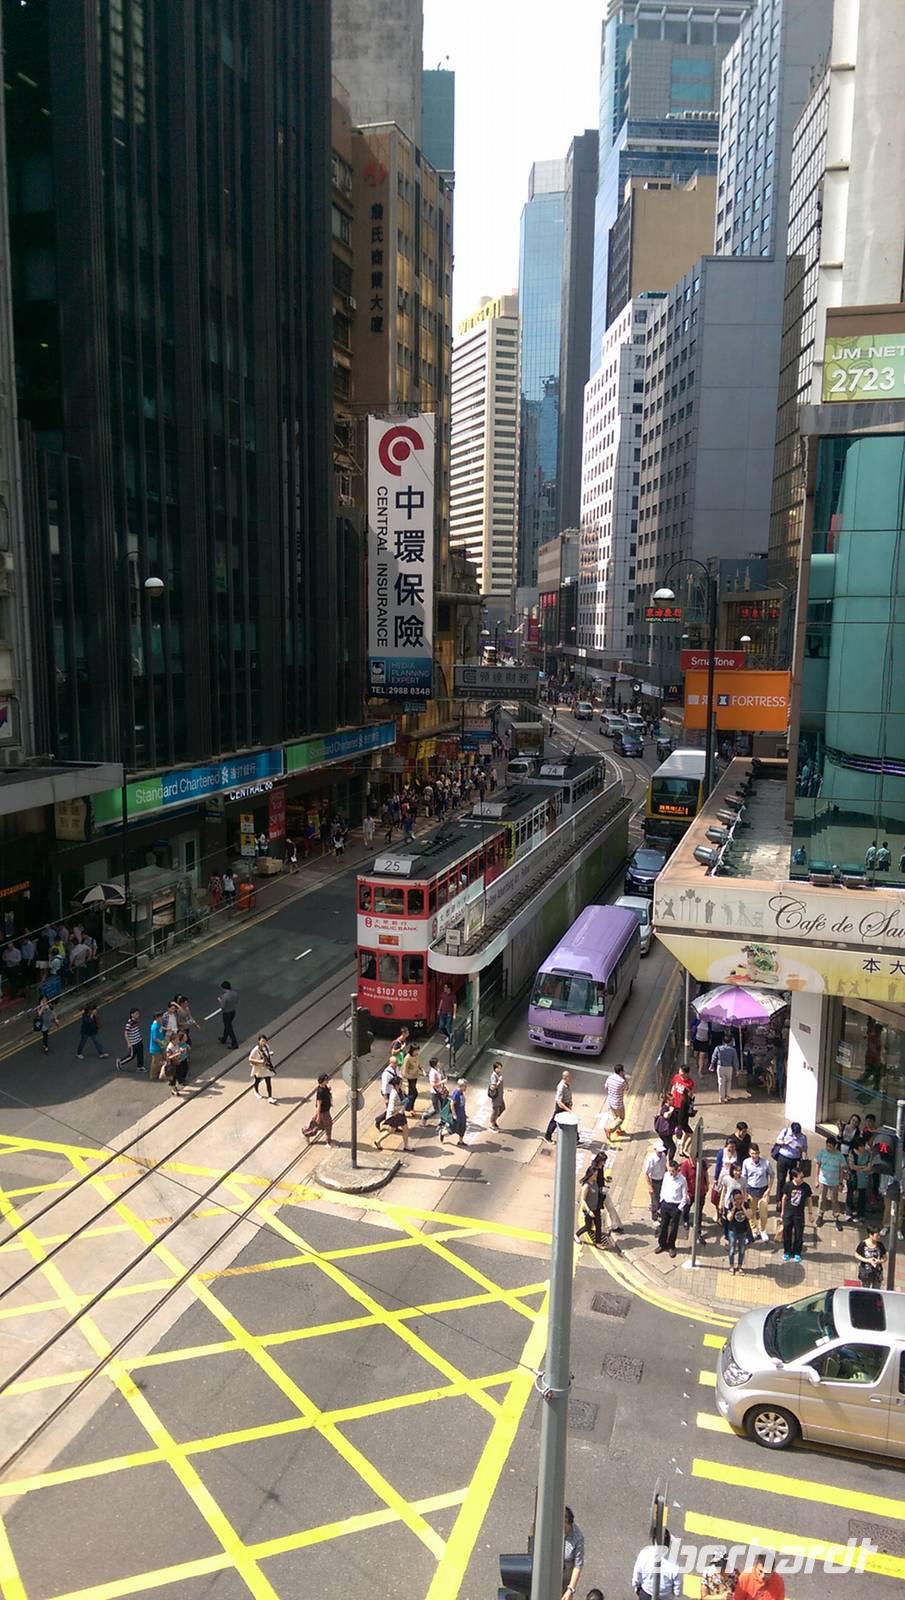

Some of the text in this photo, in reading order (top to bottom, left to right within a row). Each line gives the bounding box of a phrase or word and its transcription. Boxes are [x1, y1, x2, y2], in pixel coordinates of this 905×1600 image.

[832, 347, 861, 360] JM
[830, 367, 896, 393] 2723
[376, 486, 388, 647] CENTRAL INSURANCE
[394, 485, 425, 648] 中環保險
[731, 695, 786, 707] FORTRESS
[135, 773, 220, 805] Standard Chartered
[229, 784, 264, 800] CENTRAL
[384, 860, 400, 872] 25
[768, 895, 827, 936] Café
[831, 916, 854, 933] de
[376, 986, 396, 995] 8107
[397, 989, 418, 997] 0818
